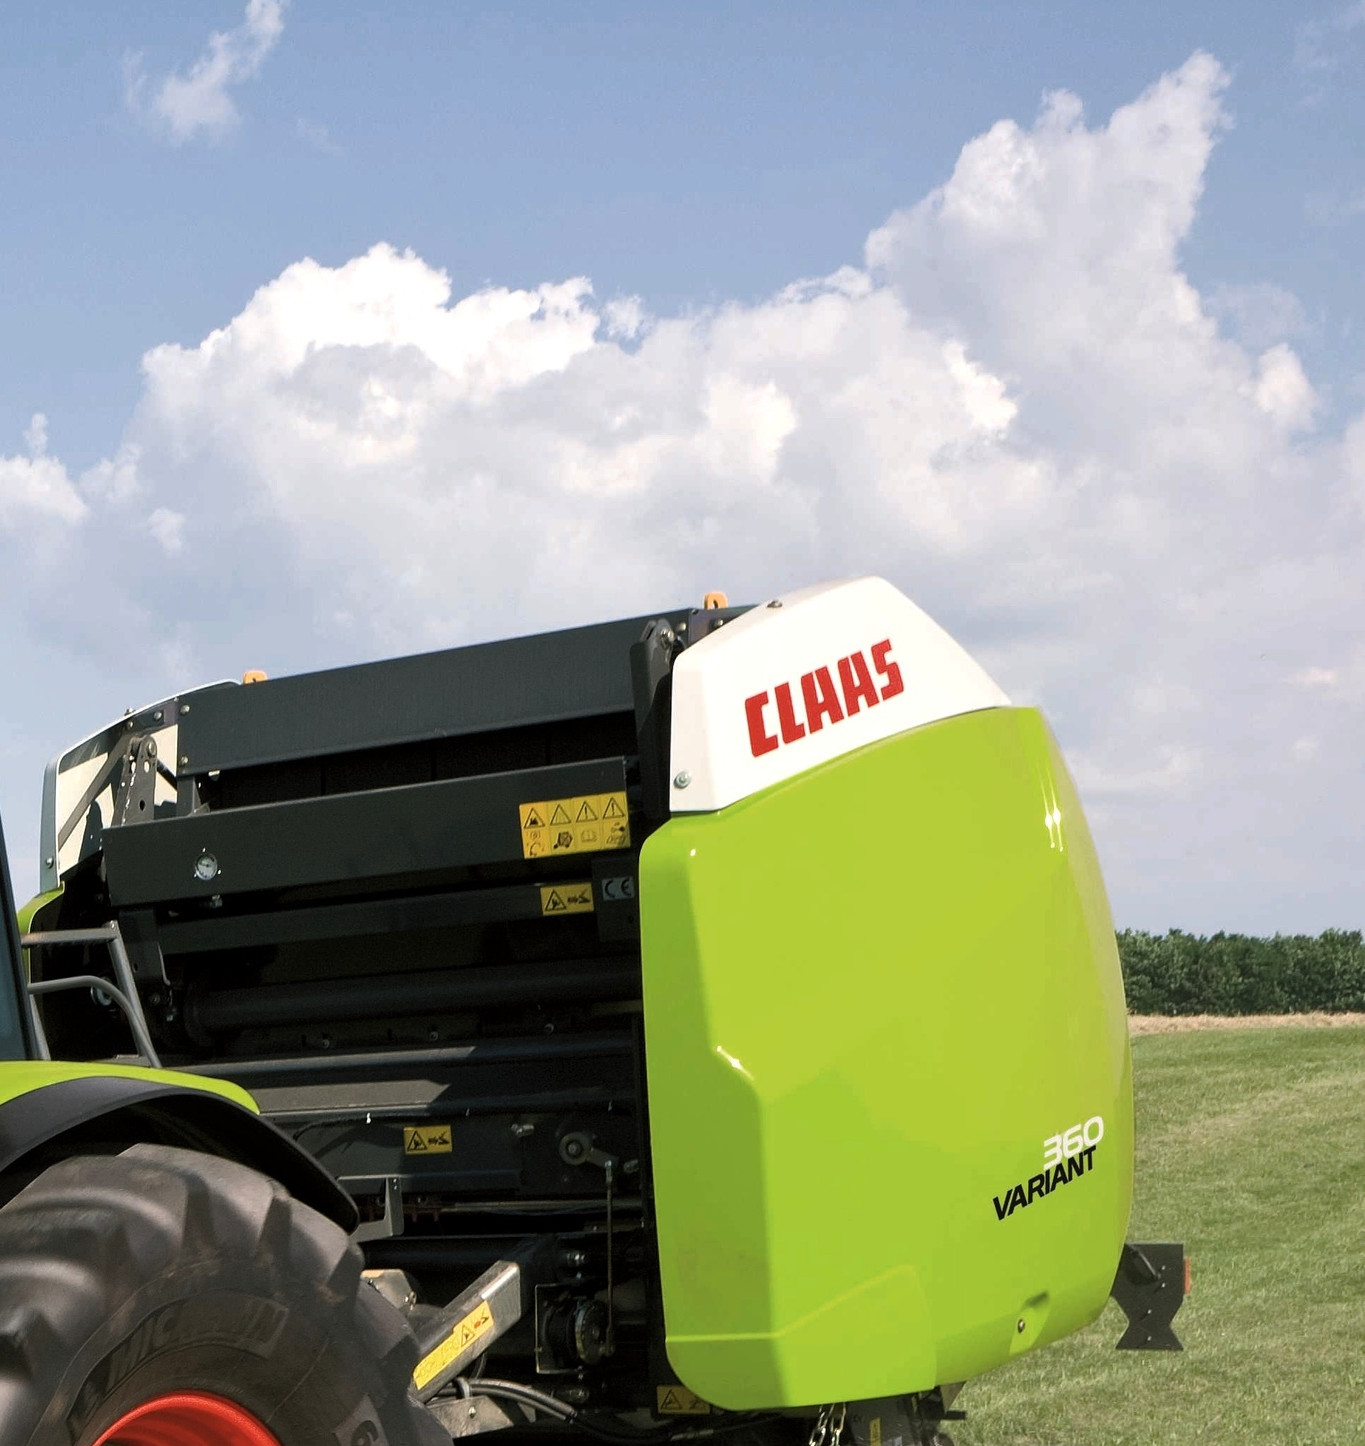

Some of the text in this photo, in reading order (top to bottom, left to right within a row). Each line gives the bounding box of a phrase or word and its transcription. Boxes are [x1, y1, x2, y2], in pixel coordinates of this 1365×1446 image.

[744, 638, 905, 758] CLAAS
[1043, 1115, 1105, 1171] 360
[992, 1144, 1097, 1221] VARIANT
